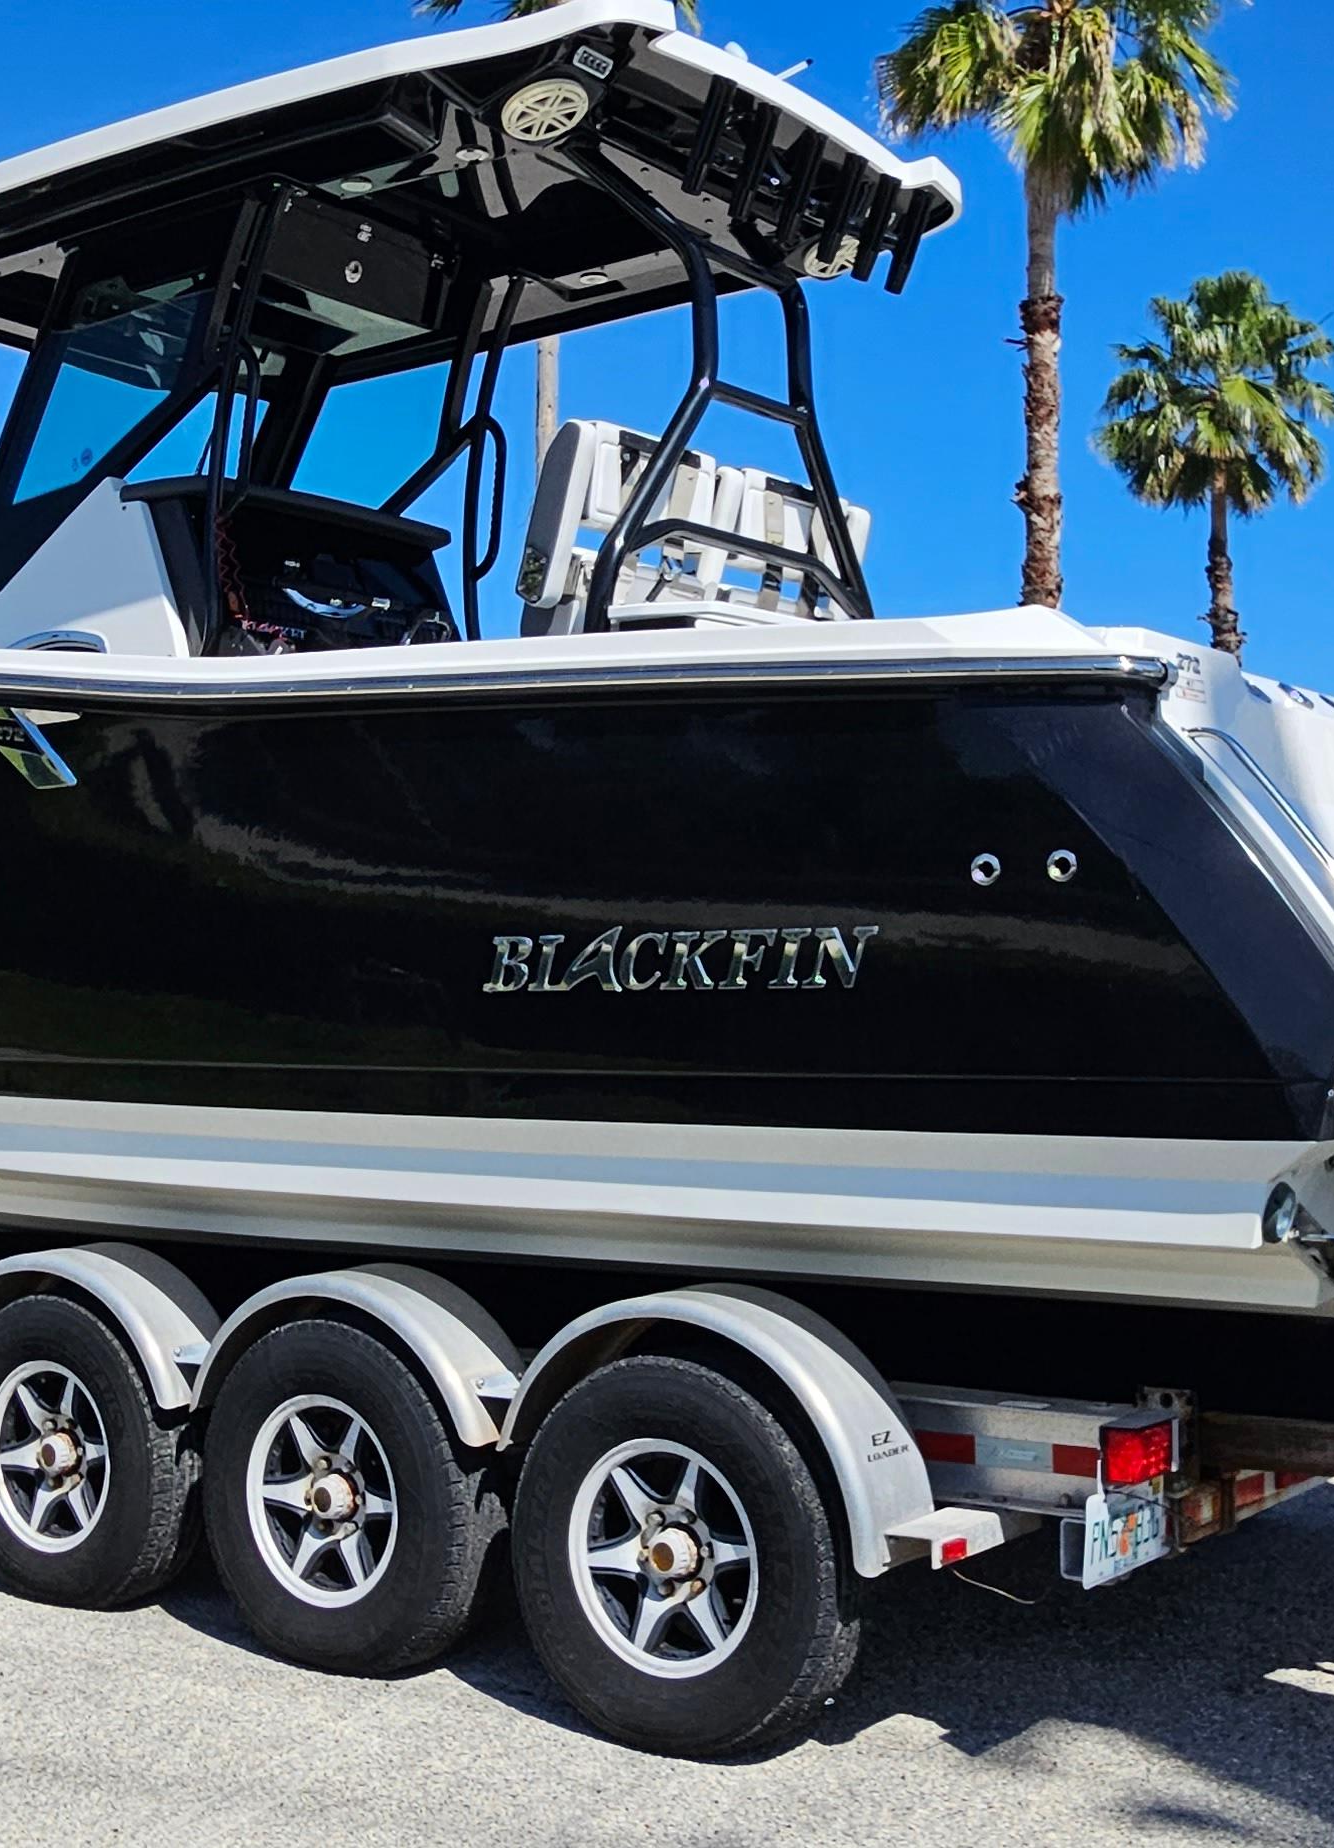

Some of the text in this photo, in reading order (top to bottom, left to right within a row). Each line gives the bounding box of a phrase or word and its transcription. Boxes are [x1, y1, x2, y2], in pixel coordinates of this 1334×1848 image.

[1176, 651, 1201, 675] 272
[483, 925, 879, 992] BLACKFIN
[871, 1430, 895, 1447] EZ
[867, 1444, 909, 1463] LOADER
